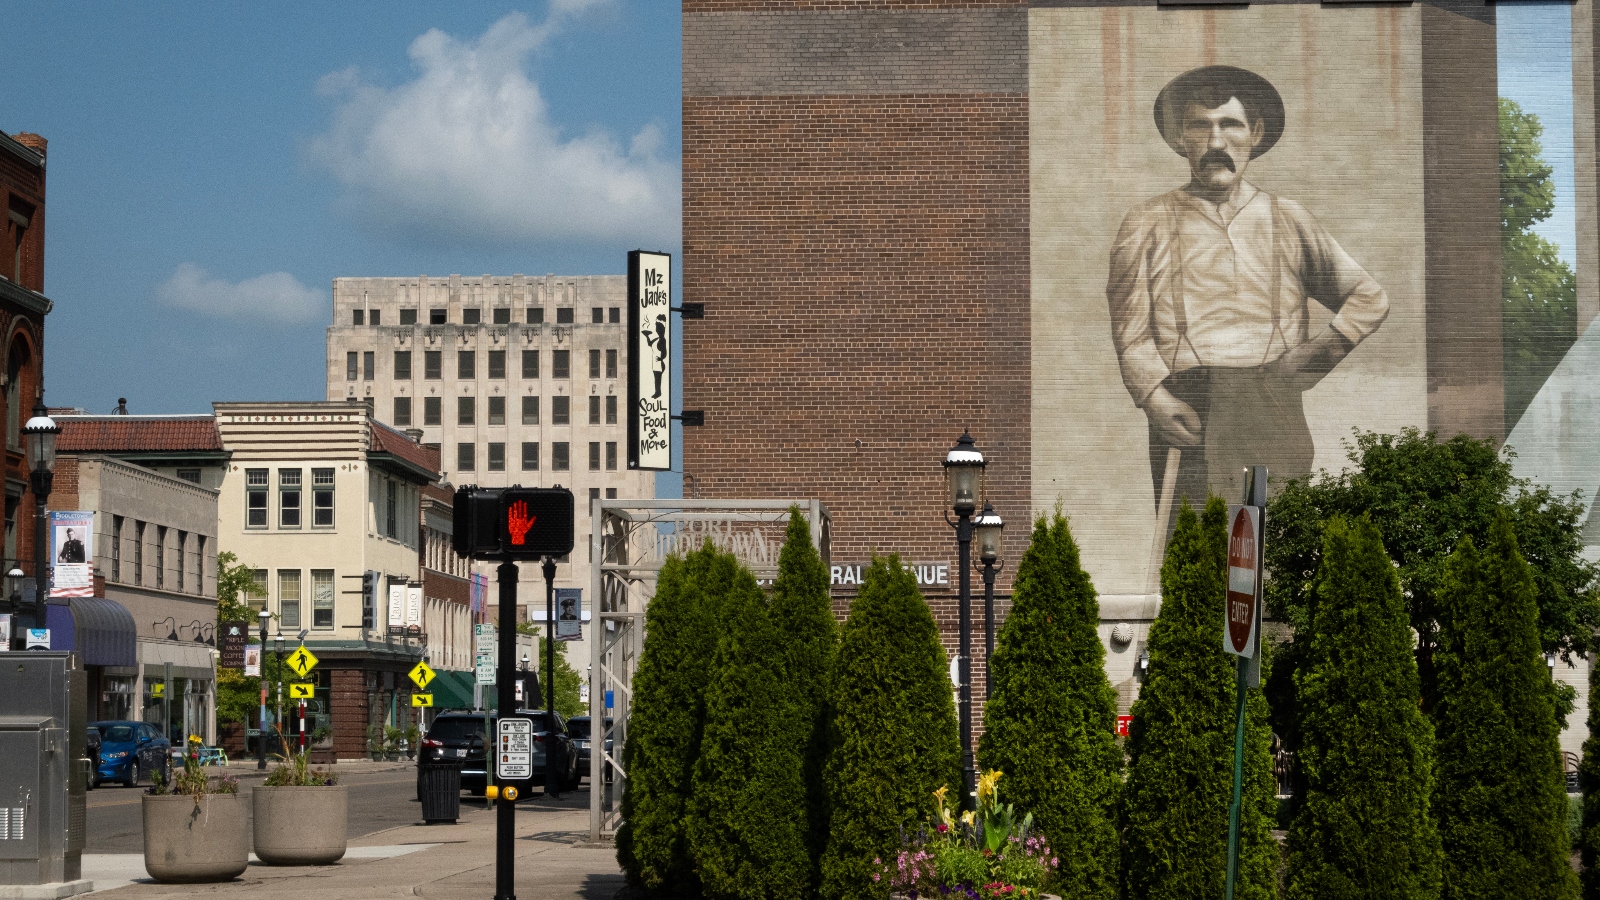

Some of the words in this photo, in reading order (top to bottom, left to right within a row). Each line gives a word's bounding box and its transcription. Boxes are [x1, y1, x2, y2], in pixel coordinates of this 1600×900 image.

[645, 268, 663, 287] Mz
[641, 286, 667, 308] Jade's
[644, 413, 666, 431] Food
[648, 428, 658, 439] &
[641, 439, 667, 455] More
[675, 518, 736, 533] PORT
[1232, 537, 1240, 557] DO
[1241, 537, 1253, 560] NOT
[364, 573, 374, 629] PRIMO
[390, 591, 402, 621] PRIMO
[408, 593, 419, 622] PRIMO
[1231, 600, 1249, 625] ENTER
[476, 627, 481, 635] 2
